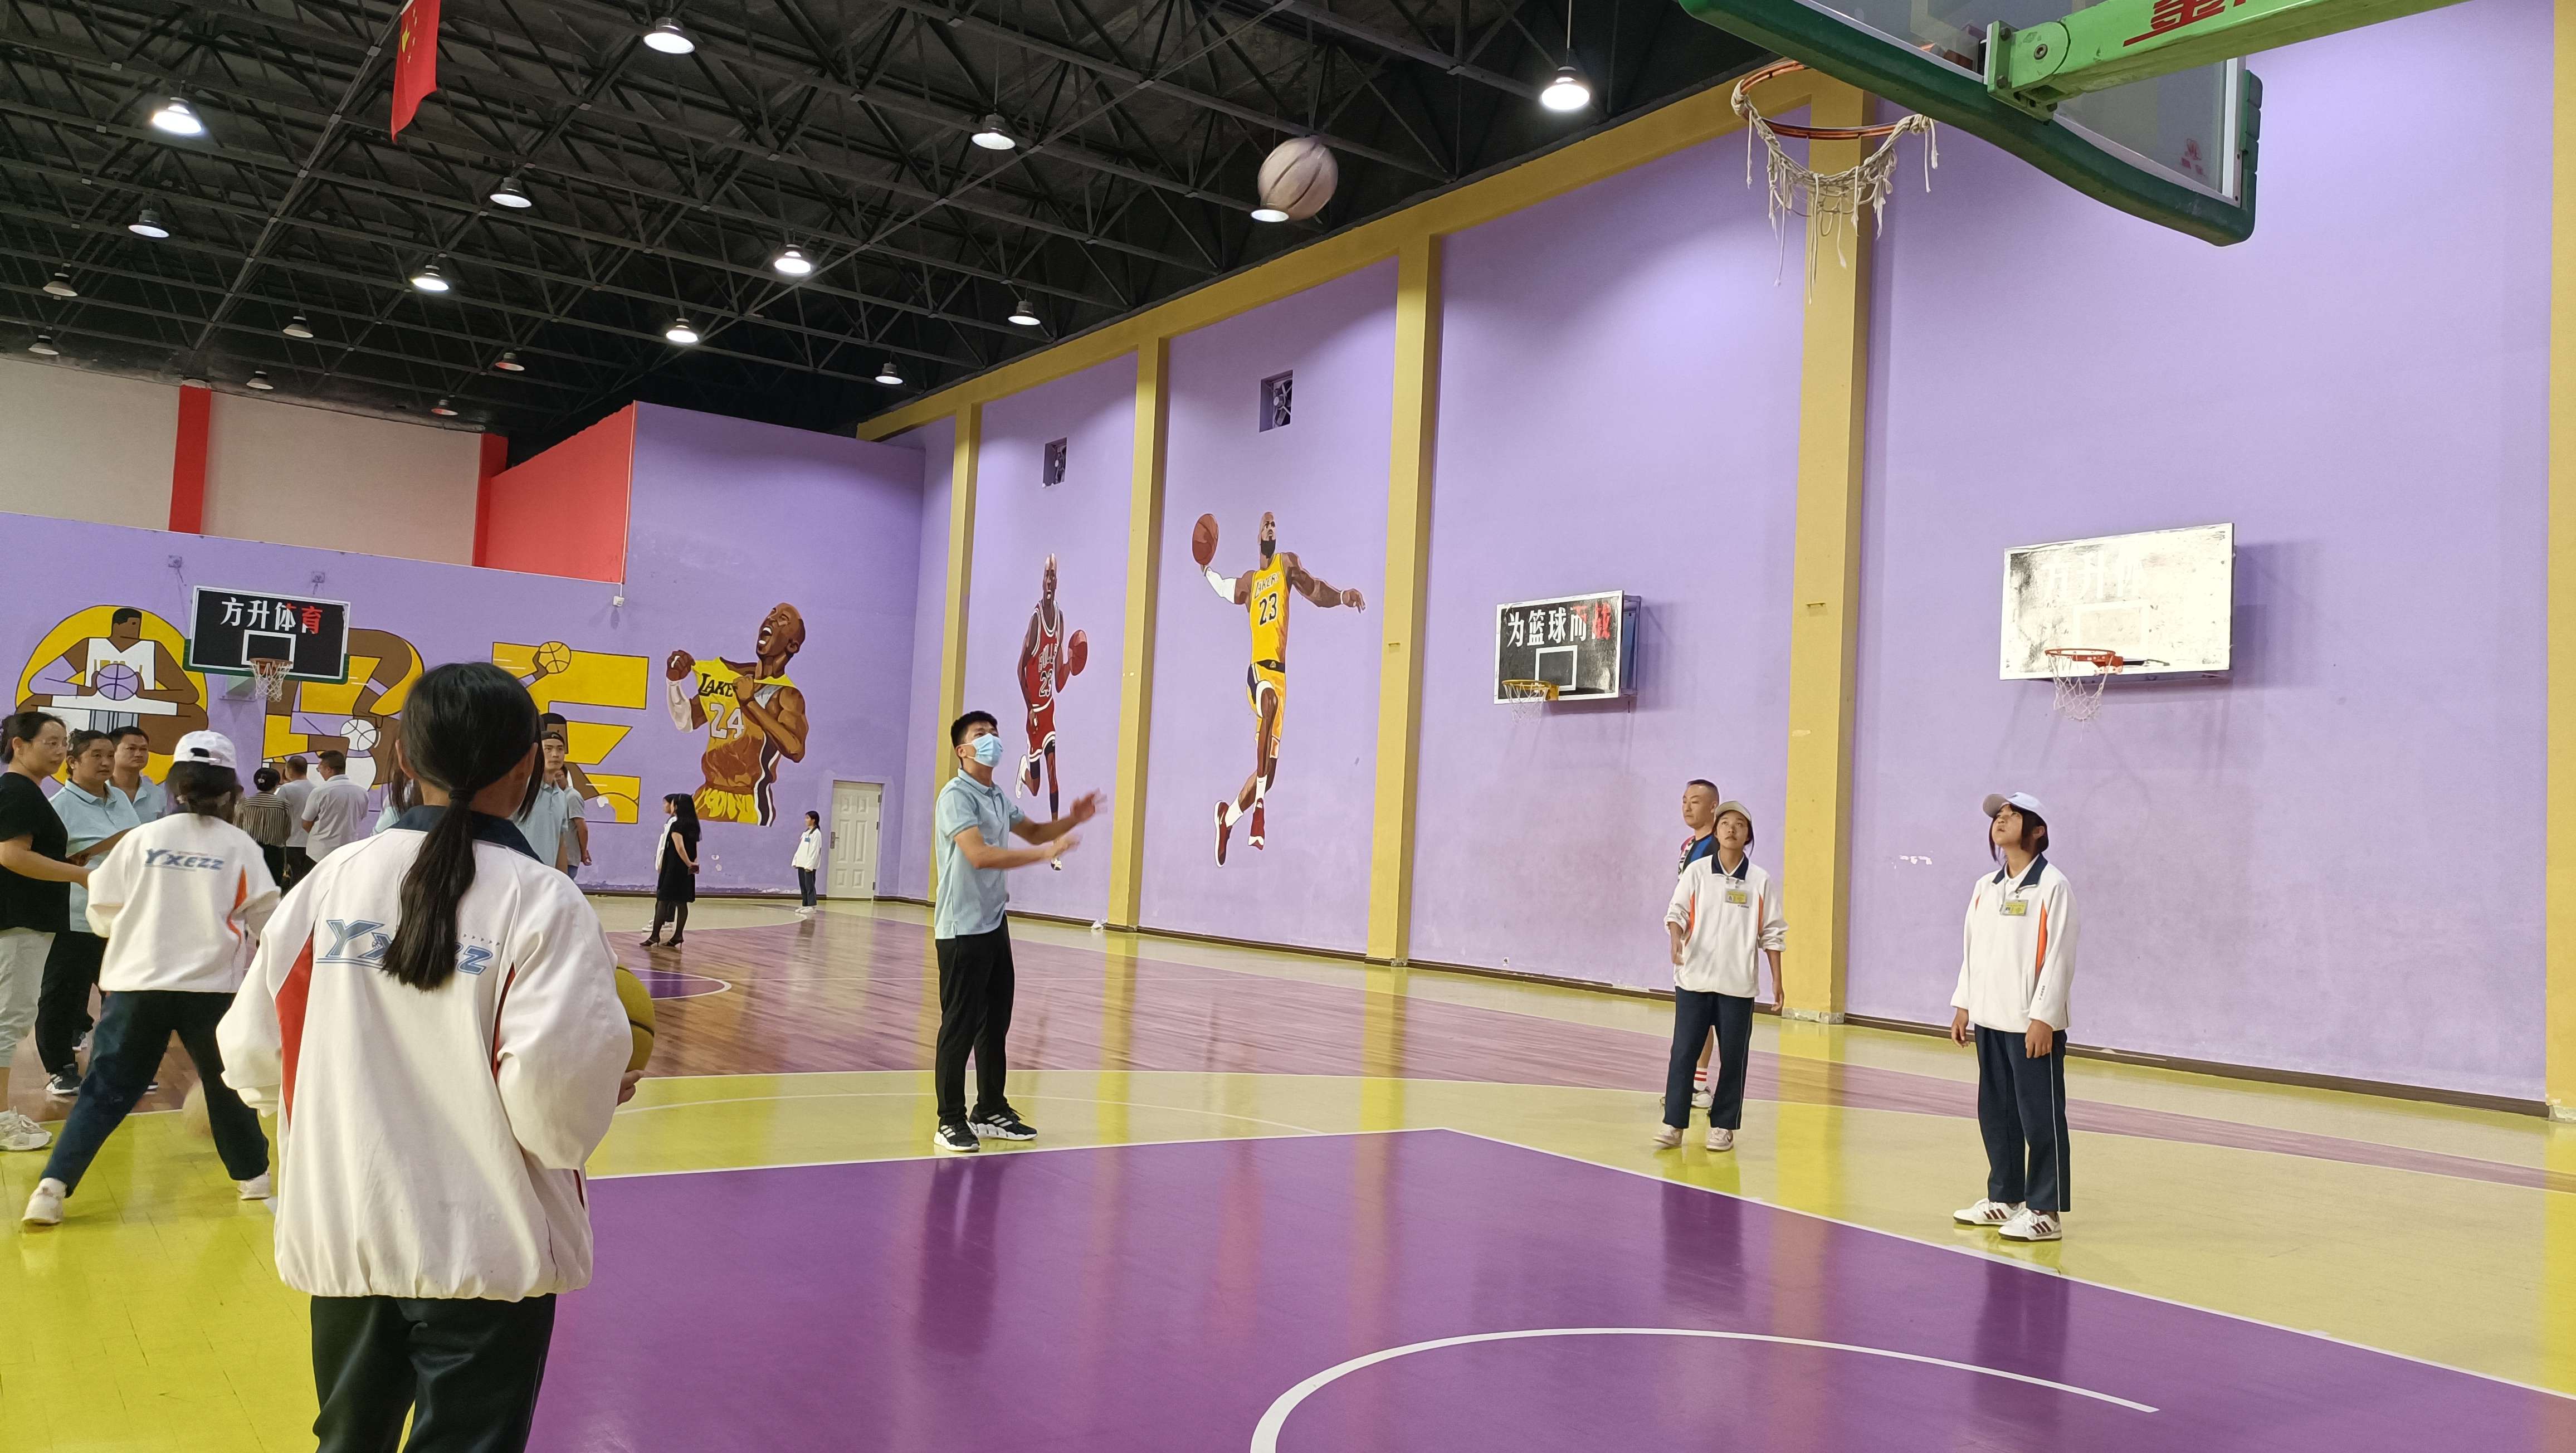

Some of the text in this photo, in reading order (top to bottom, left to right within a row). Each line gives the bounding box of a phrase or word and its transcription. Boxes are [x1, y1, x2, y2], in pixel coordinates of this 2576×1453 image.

[220, 597, 323, 635] 方升体育
[1258, 592, 1278, 626] 23
[1039, 668, 1053, 698] 23
[710, 702, 745, 740] 24
